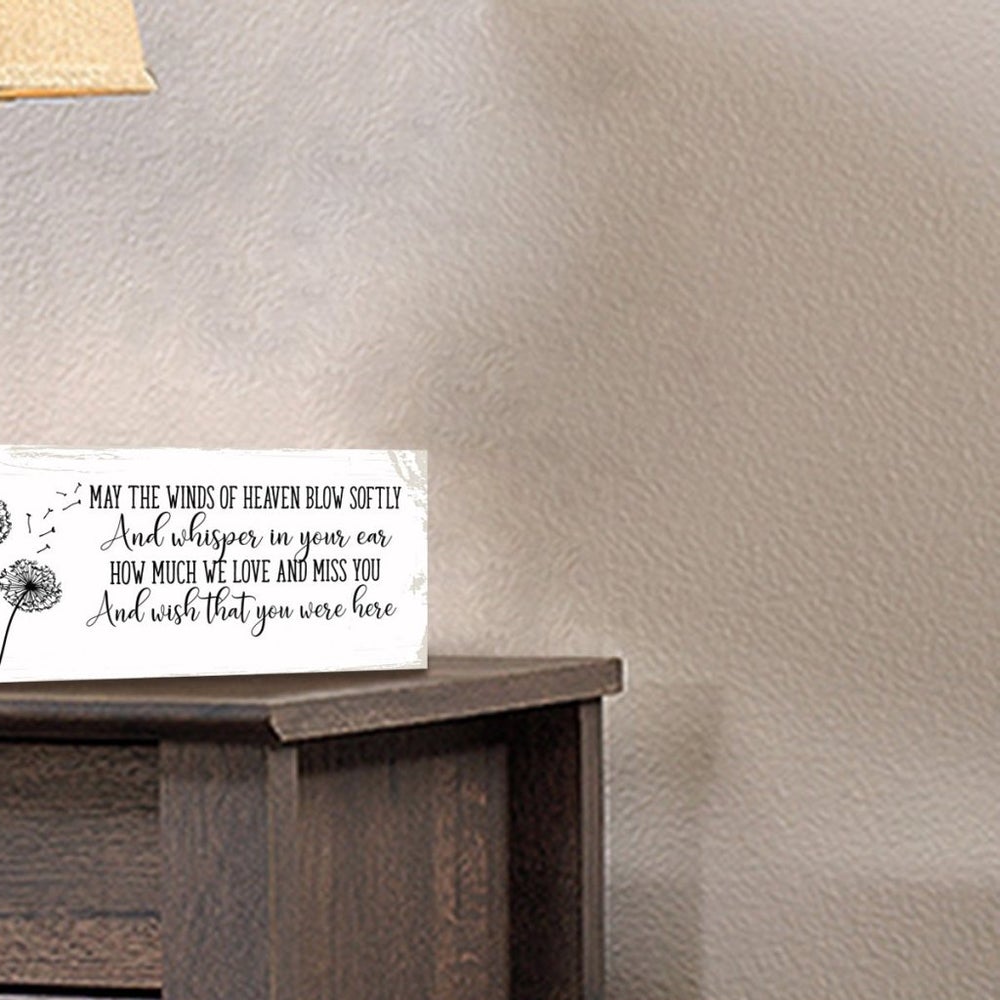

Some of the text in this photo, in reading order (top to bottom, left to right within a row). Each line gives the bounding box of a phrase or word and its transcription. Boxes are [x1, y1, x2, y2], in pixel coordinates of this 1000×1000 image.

[89, 485, 402, 510] MAY THE WINDS OF HEAVEN BLOW SOFTLY
[100, 511, 393, 563] And whisper in your ear
[110, 558, 381, 584] HOW MUCH WE LOVE AND MISS YOU
[86, 584, 397, 637] And wish that you were here
